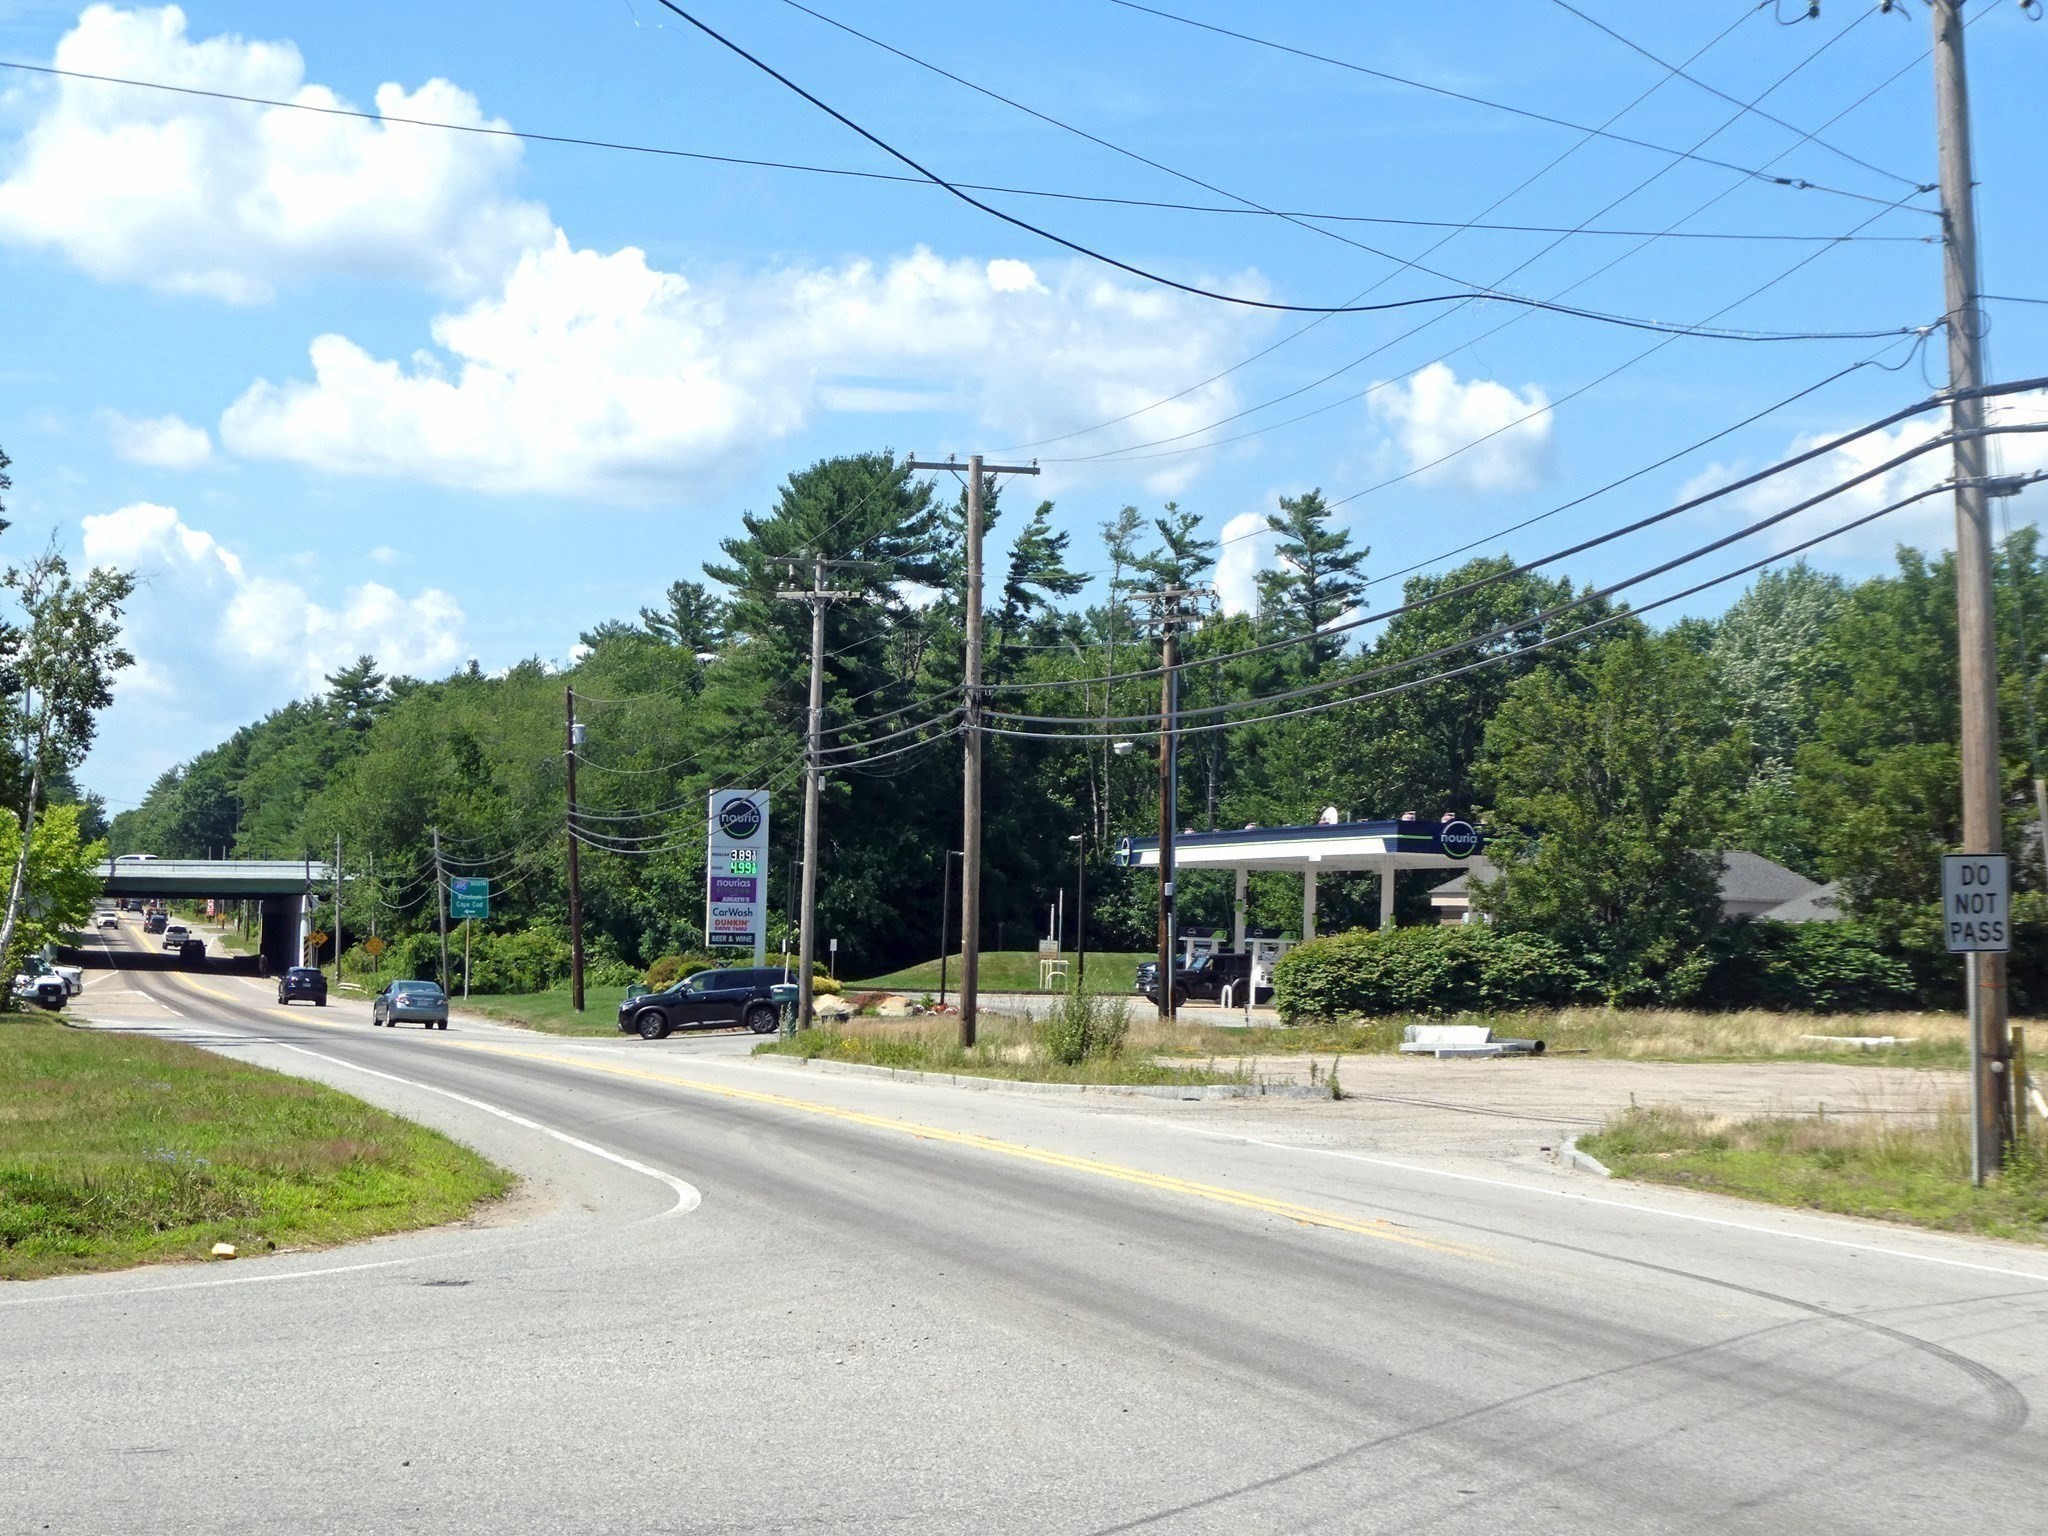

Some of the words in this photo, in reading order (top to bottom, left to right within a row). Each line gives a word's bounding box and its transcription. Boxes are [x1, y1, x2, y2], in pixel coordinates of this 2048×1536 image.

[721, 813, 759, 823] nouria
[1440, 833, 1477, 844] nouria
[1961, 864, 1990, 886] DO
[716, 878, 751, 888] nourias
[1955, 892, 1997, 914] NOT
[712, 907, 753, 917] CarWash
[1950, 920, 2004, 942] PASS
[735, 935, 753, 943] WINE
